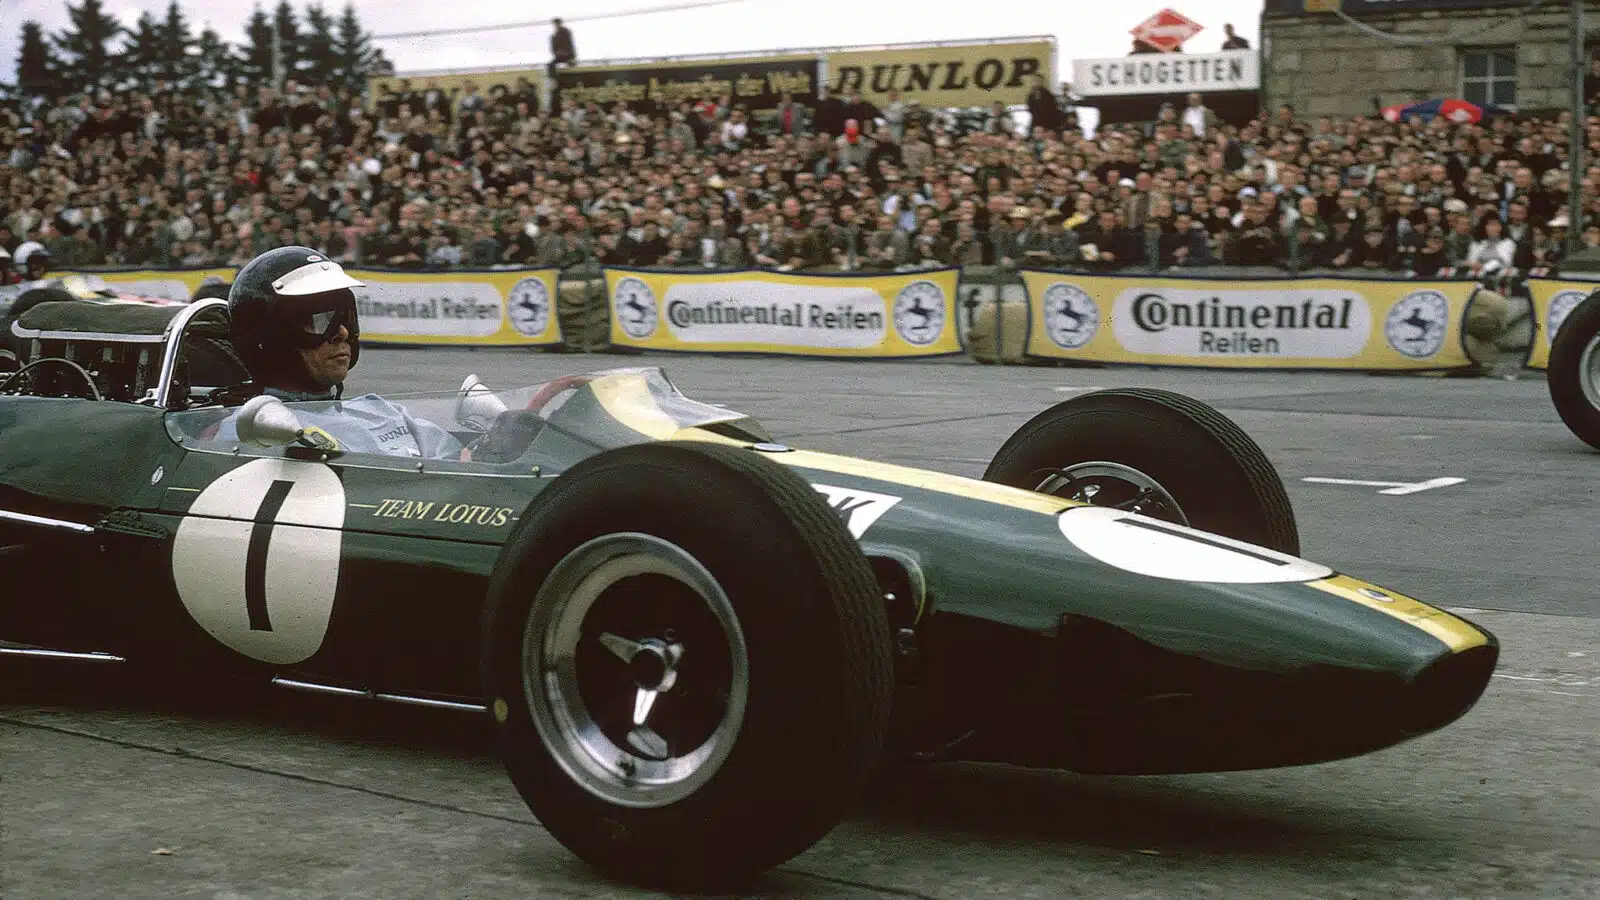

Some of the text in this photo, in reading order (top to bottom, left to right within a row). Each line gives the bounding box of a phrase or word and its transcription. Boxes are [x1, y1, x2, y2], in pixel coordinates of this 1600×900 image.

[829, 58, 1040, 95] DUNLOP
[1091, 57, 1243, 87] SCHOGETTEN
[668, 300, 883, 330] Continental Reifen
[1131, 293, 1351, 332] Continental
[1202, 331, 1281, 354] Reifen
[374, 499, 513, 527] TEAM LOTUS
[245, 479, 296, 632] 1
[1112, 517, 1291, 566] 1
